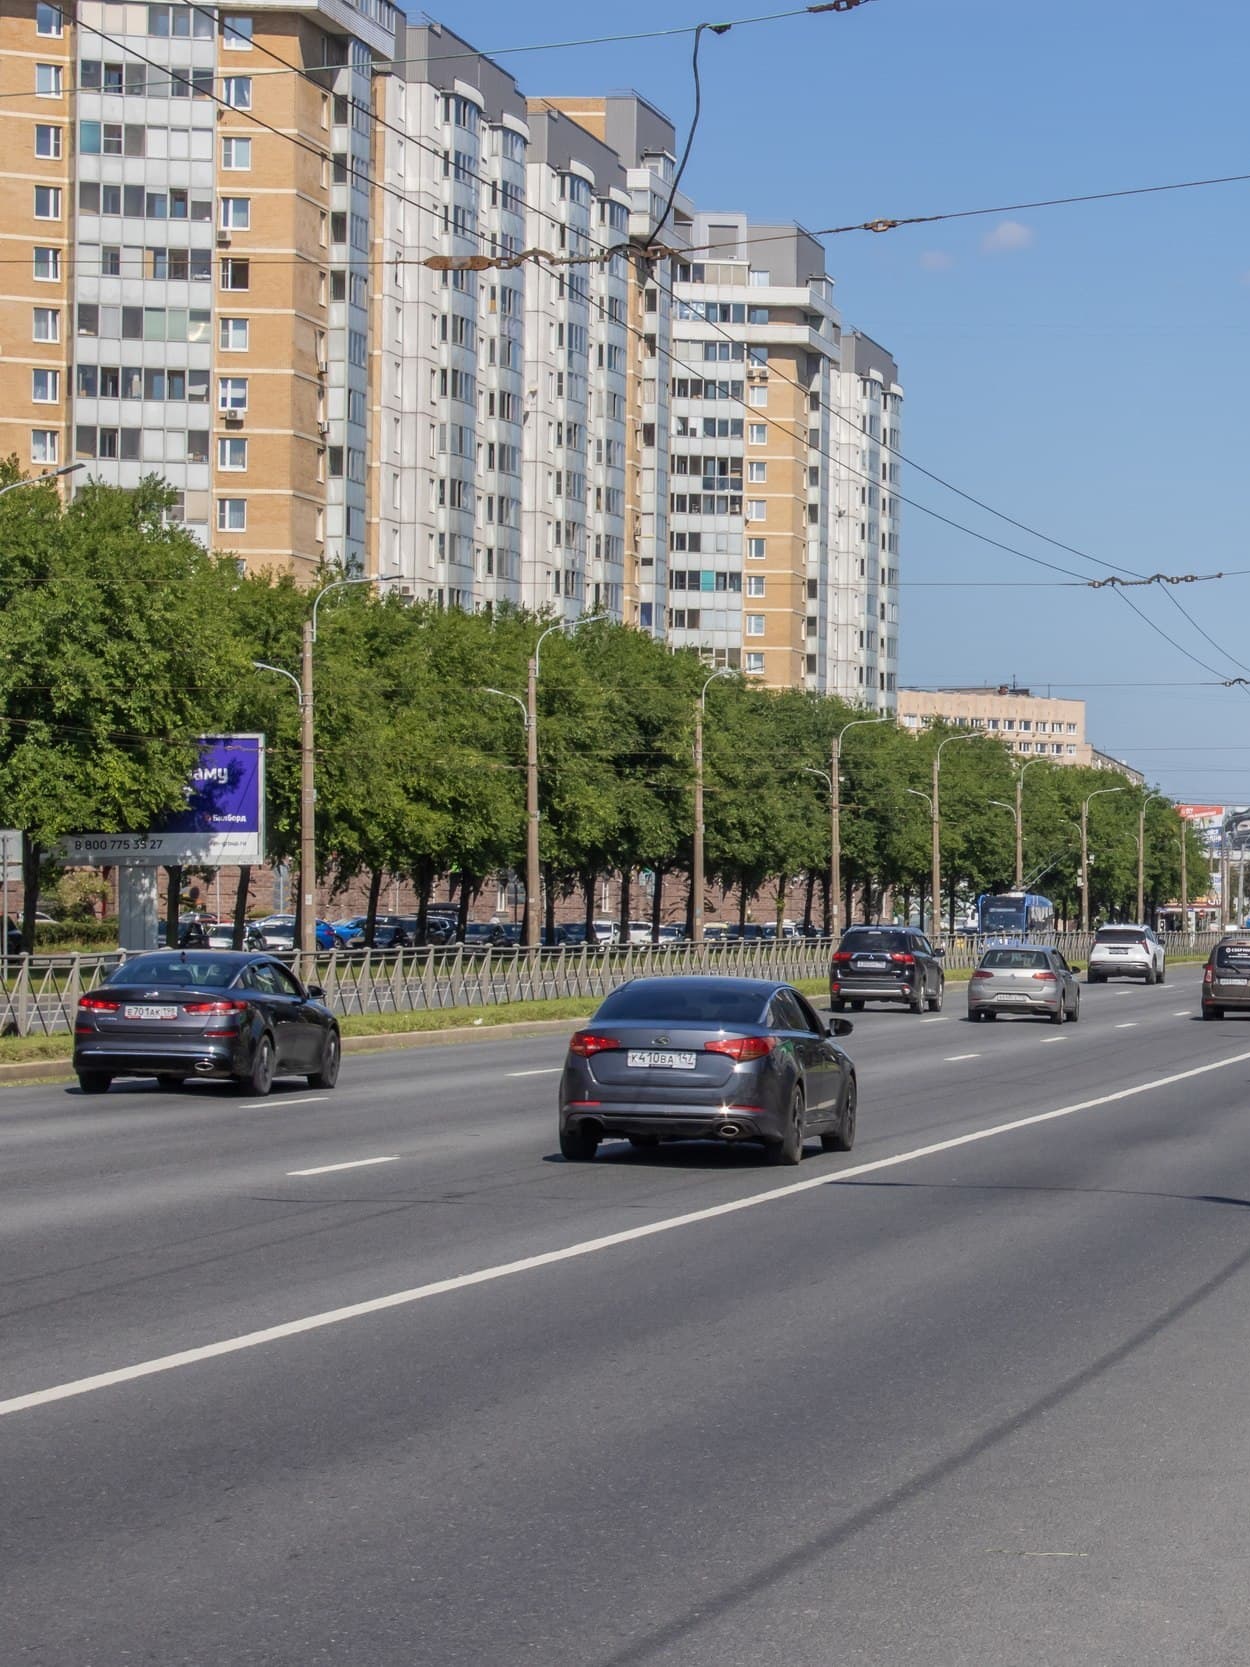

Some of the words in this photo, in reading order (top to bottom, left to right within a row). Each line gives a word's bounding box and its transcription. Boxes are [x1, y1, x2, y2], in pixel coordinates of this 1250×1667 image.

[212, 812, 247, 824] Билборд
[74, 840, 82, 850] 8
[85, 840, 107, 850] 800
[110, 840, 130, 850] 775
[150, 839, 164, 849] 27
